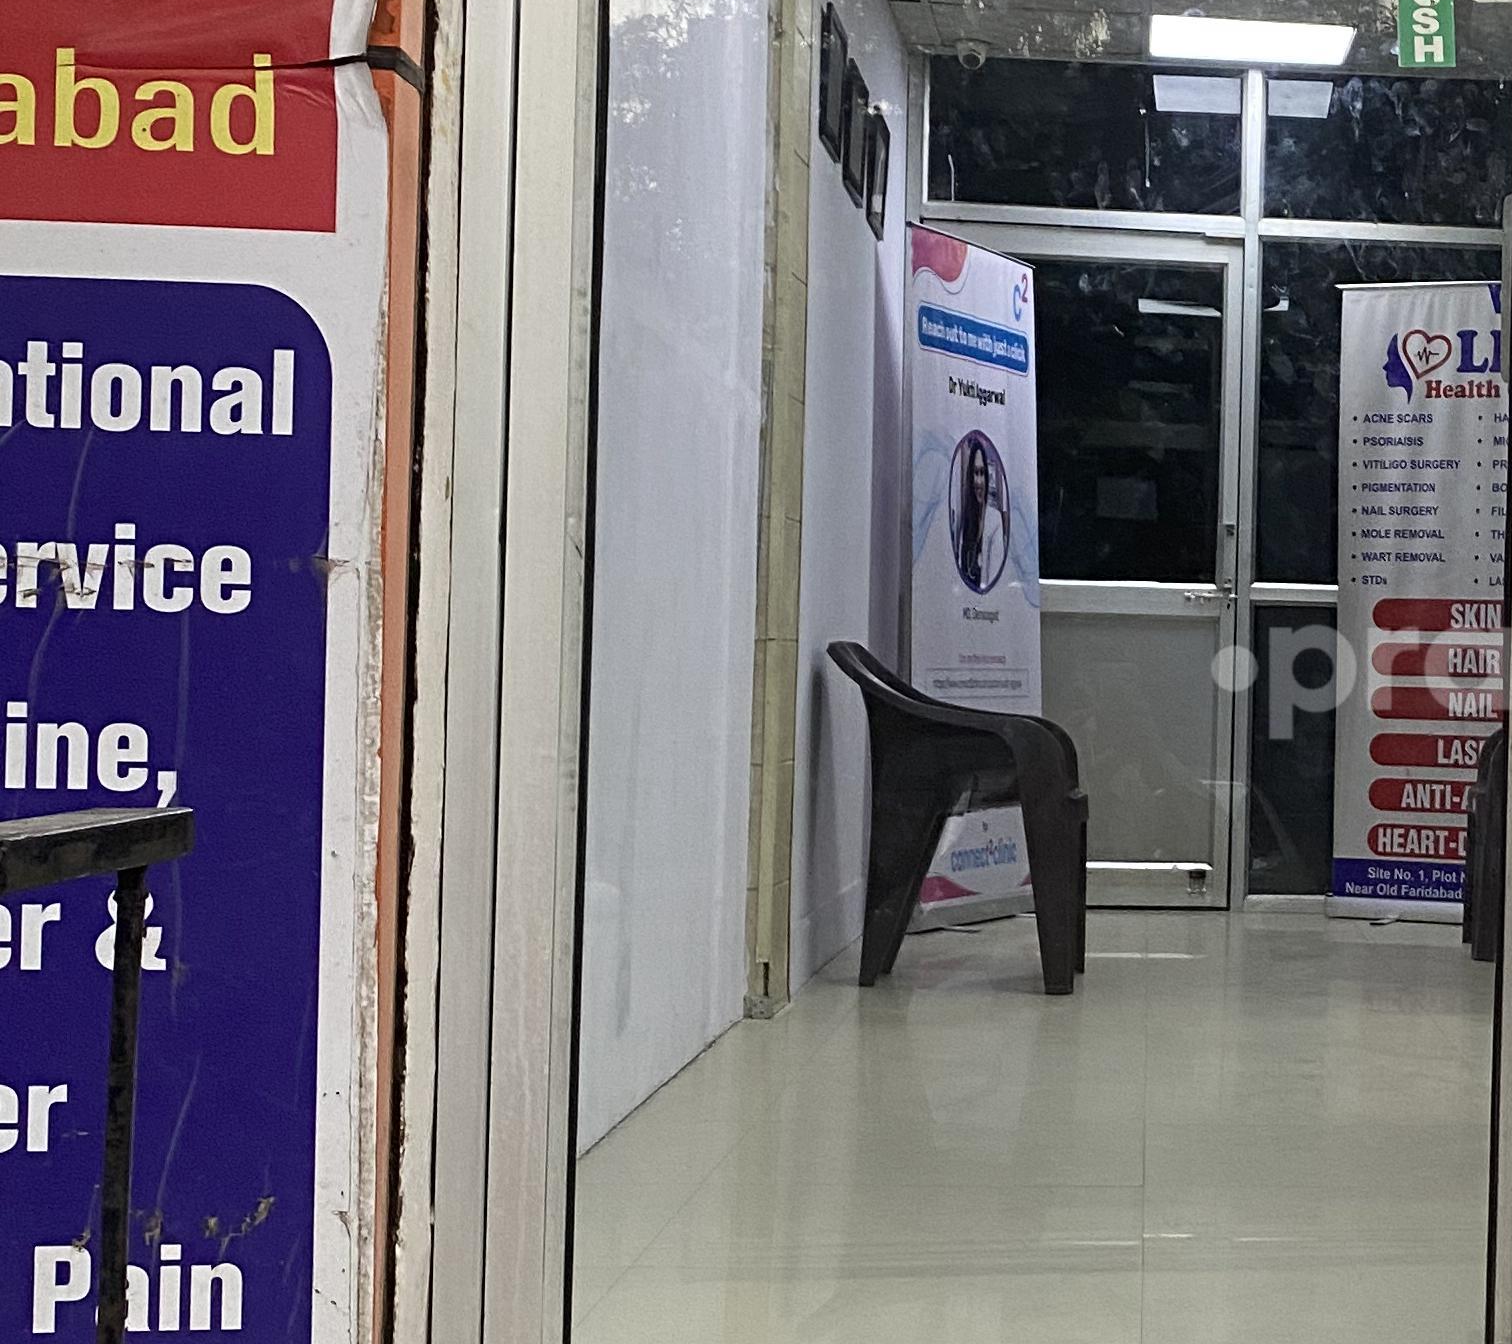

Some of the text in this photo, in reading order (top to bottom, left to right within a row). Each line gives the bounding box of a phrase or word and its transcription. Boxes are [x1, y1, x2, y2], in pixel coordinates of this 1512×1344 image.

[0, 340, 295, 436] tional
[1424, 379, 1501, 399] Health
[1362, 413, 1433, 423] ACNE SCARS
[1410, 459, 1461, 469] SURGERY
[1361, 483, 1436, 493] PIGMENTATION
[1361, 506, 1440, 516] NAIL SURGERY
[1361, 529, 1445, 539] MOLE REMOVAL
[1361, 552, 1446, 562] WART REMOVAL
[0, 522, 252, 614] rvice
[1451, 603, 1502, 630] SKIN
[1448, 648, 1501, 674] HAIR
[1448, 692, 1498, 718] NAIL
[1367, 866, 1391, 879] Site
[1432, 869, 1457, 883] Plot
[1345, 881, 1462, 899] Near Old Faridabad
[0, 903, 61, 971] r
